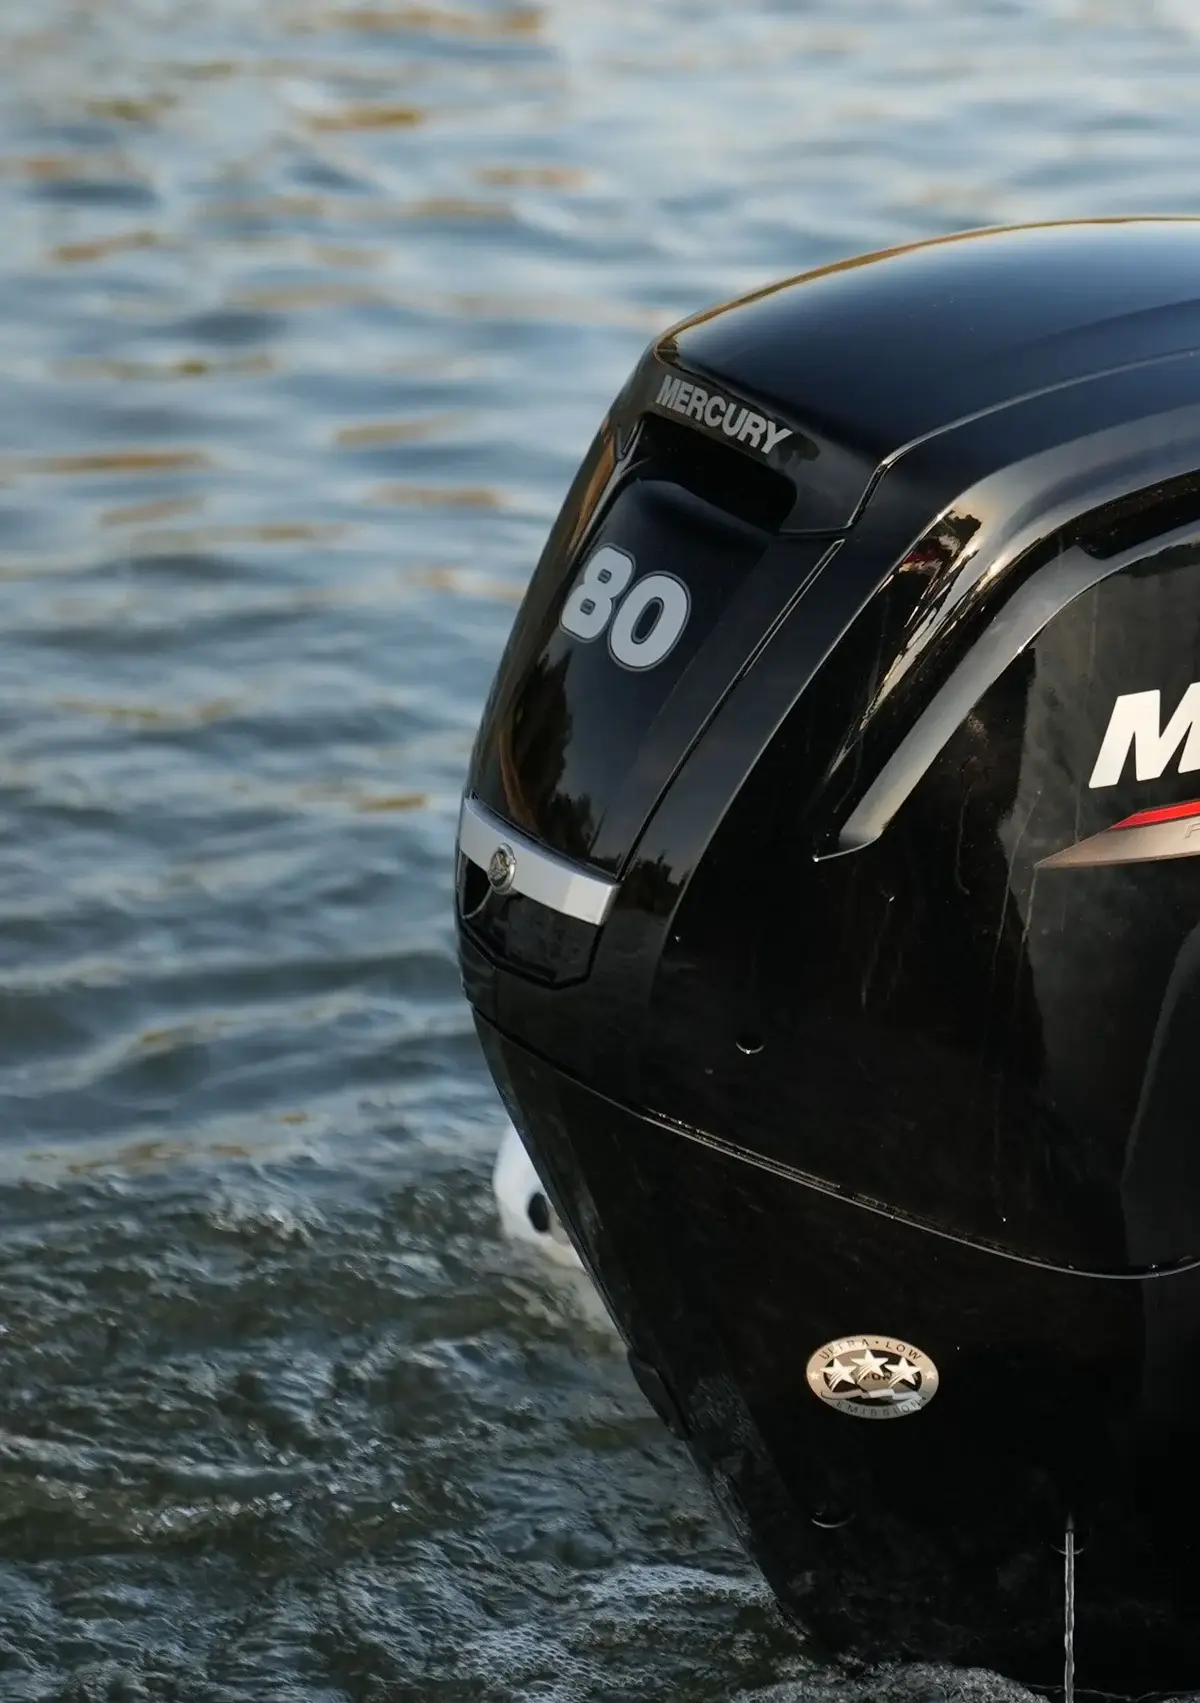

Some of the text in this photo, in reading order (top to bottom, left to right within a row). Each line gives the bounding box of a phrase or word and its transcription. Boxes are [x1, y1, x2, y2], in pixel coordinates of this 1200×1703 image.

[655, 374, 794, 455] MERCURY
[560, 544, 691, 671] 80
[885, 1340, 922, 1361] LOW
